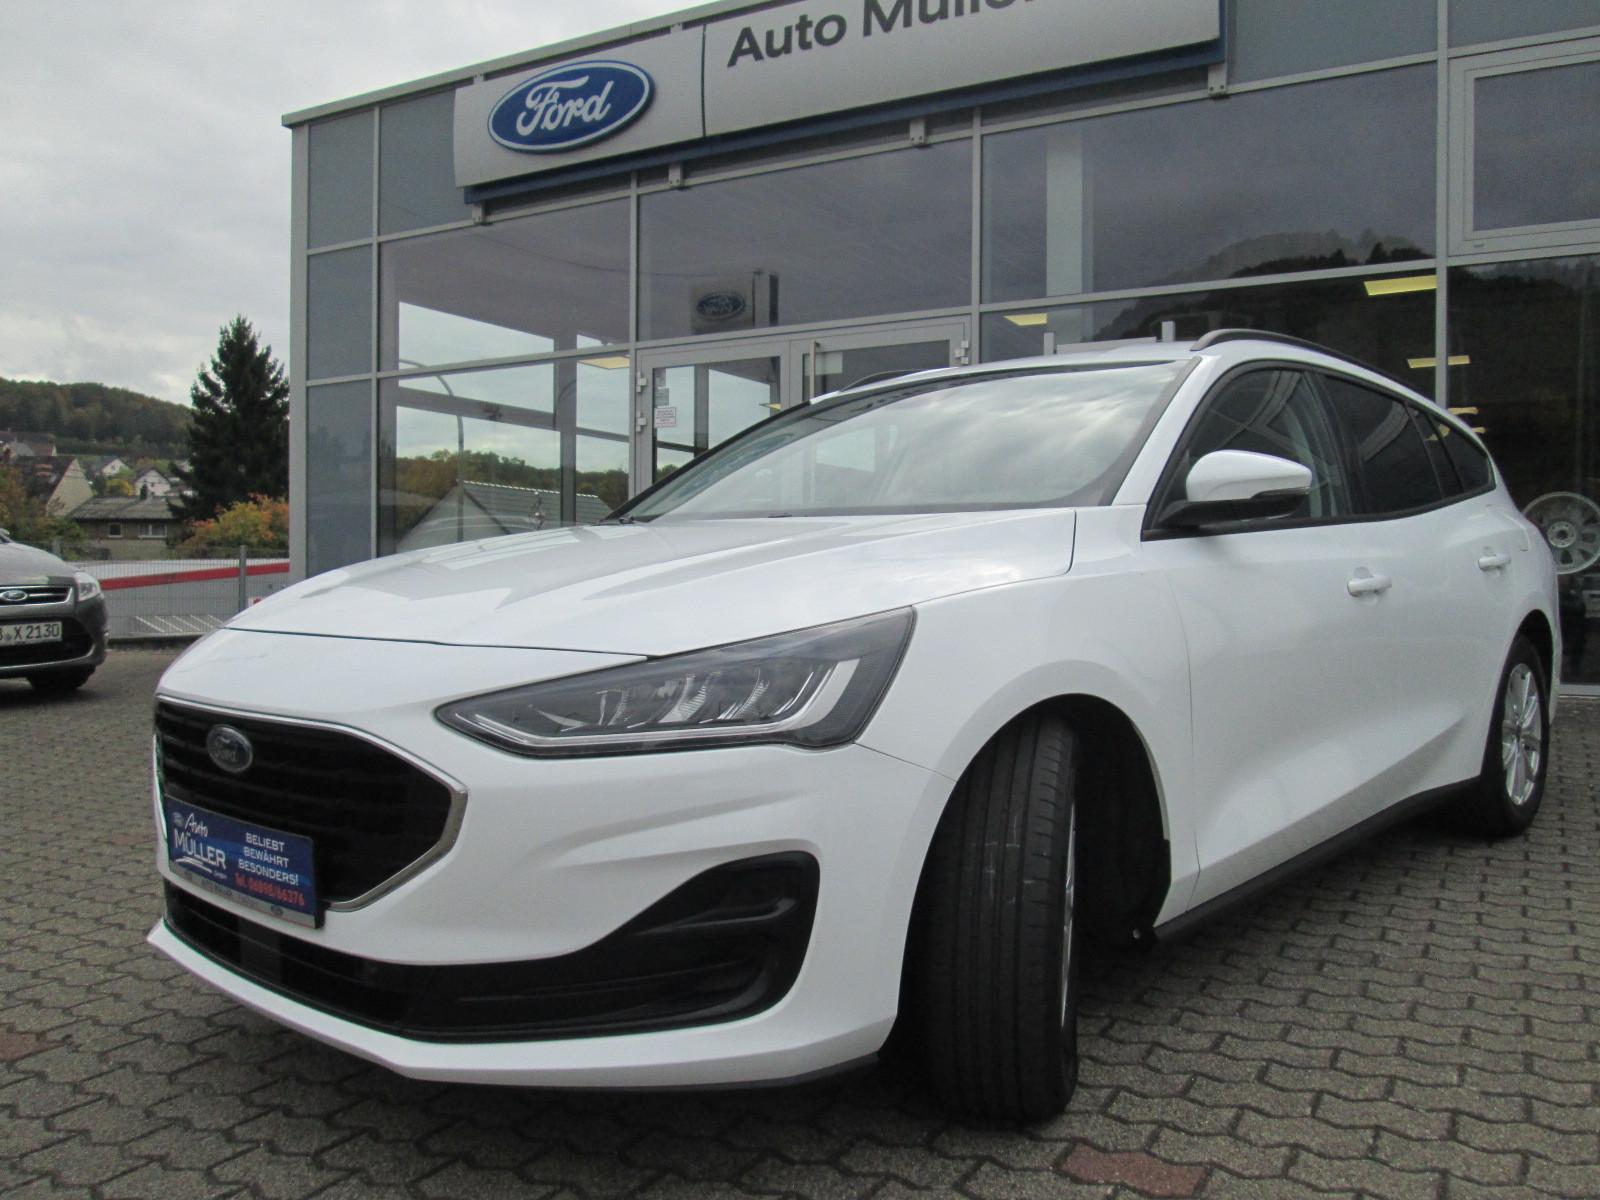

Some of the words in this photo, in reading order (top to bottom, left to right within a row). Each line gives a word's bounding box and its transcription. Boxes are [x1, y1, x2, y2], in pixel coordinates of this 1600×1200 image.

[727, 13, 847, 68] Auto
[516, 75, 614, 137] Ford
[14, 626, 22, 640] X
[26, 623, 60, 639] 2130
[184, 812, 209, 838] Auto
[174, 828, 227, 870] MÜLLER
[245, 832, 285, 852] BELIEBT
[243, 846, 289, 868] BEWÄHRT
[238, 858, 299, 886] BESONDERS!
